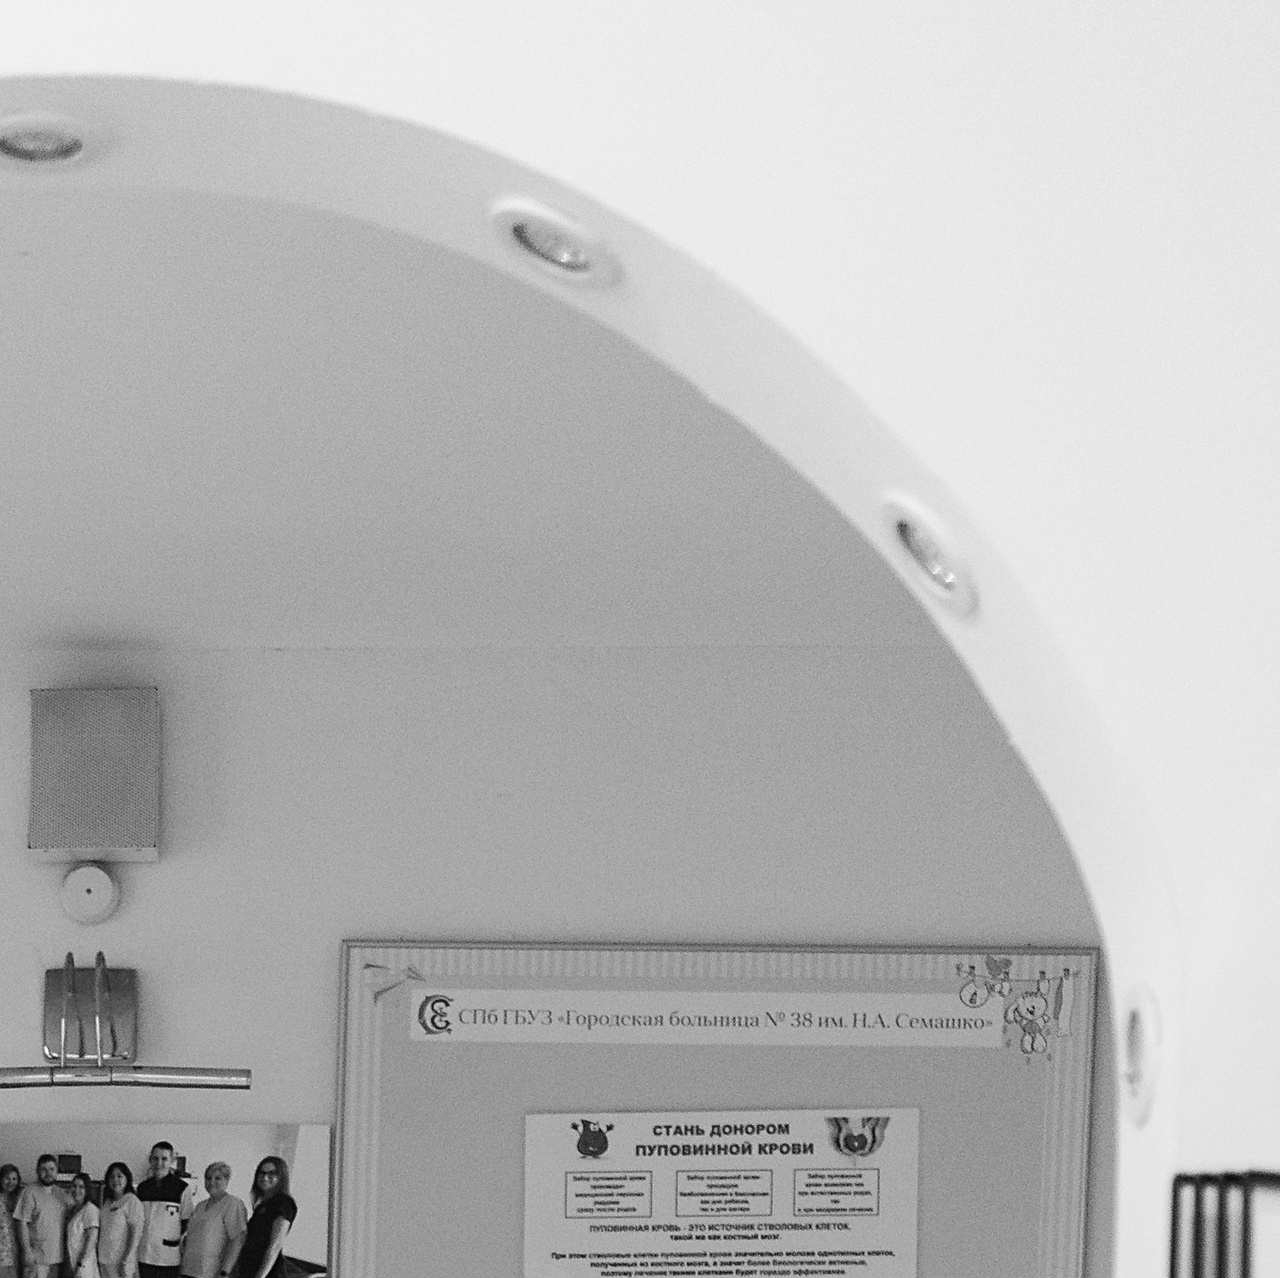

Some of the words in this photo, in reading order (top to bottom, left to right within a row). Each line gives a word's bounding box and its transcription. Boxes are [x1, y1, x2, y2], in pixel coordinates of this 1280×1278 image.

[458, 1008, 498, 1025] СПб
[503, 1008, 553, 1025] ГБУЗ
[557, 1009, 664, 1030] «Городская
[669, 1010, 760, 1029] больница
[790, 1012, 814, 1028] 38
[852, 1013, 891, 1029] Н.А.
[895, 1013, 993, 1030] Семашко»
[652, 1125, 706, 1136] СТАНЬ
[710, 1124, 790, 1137] ДОНОРОМ
[635, 1142, 753, 1156] ПУПОВИННОЙ
[758, 1143, 815, 1155] КРОВИ
